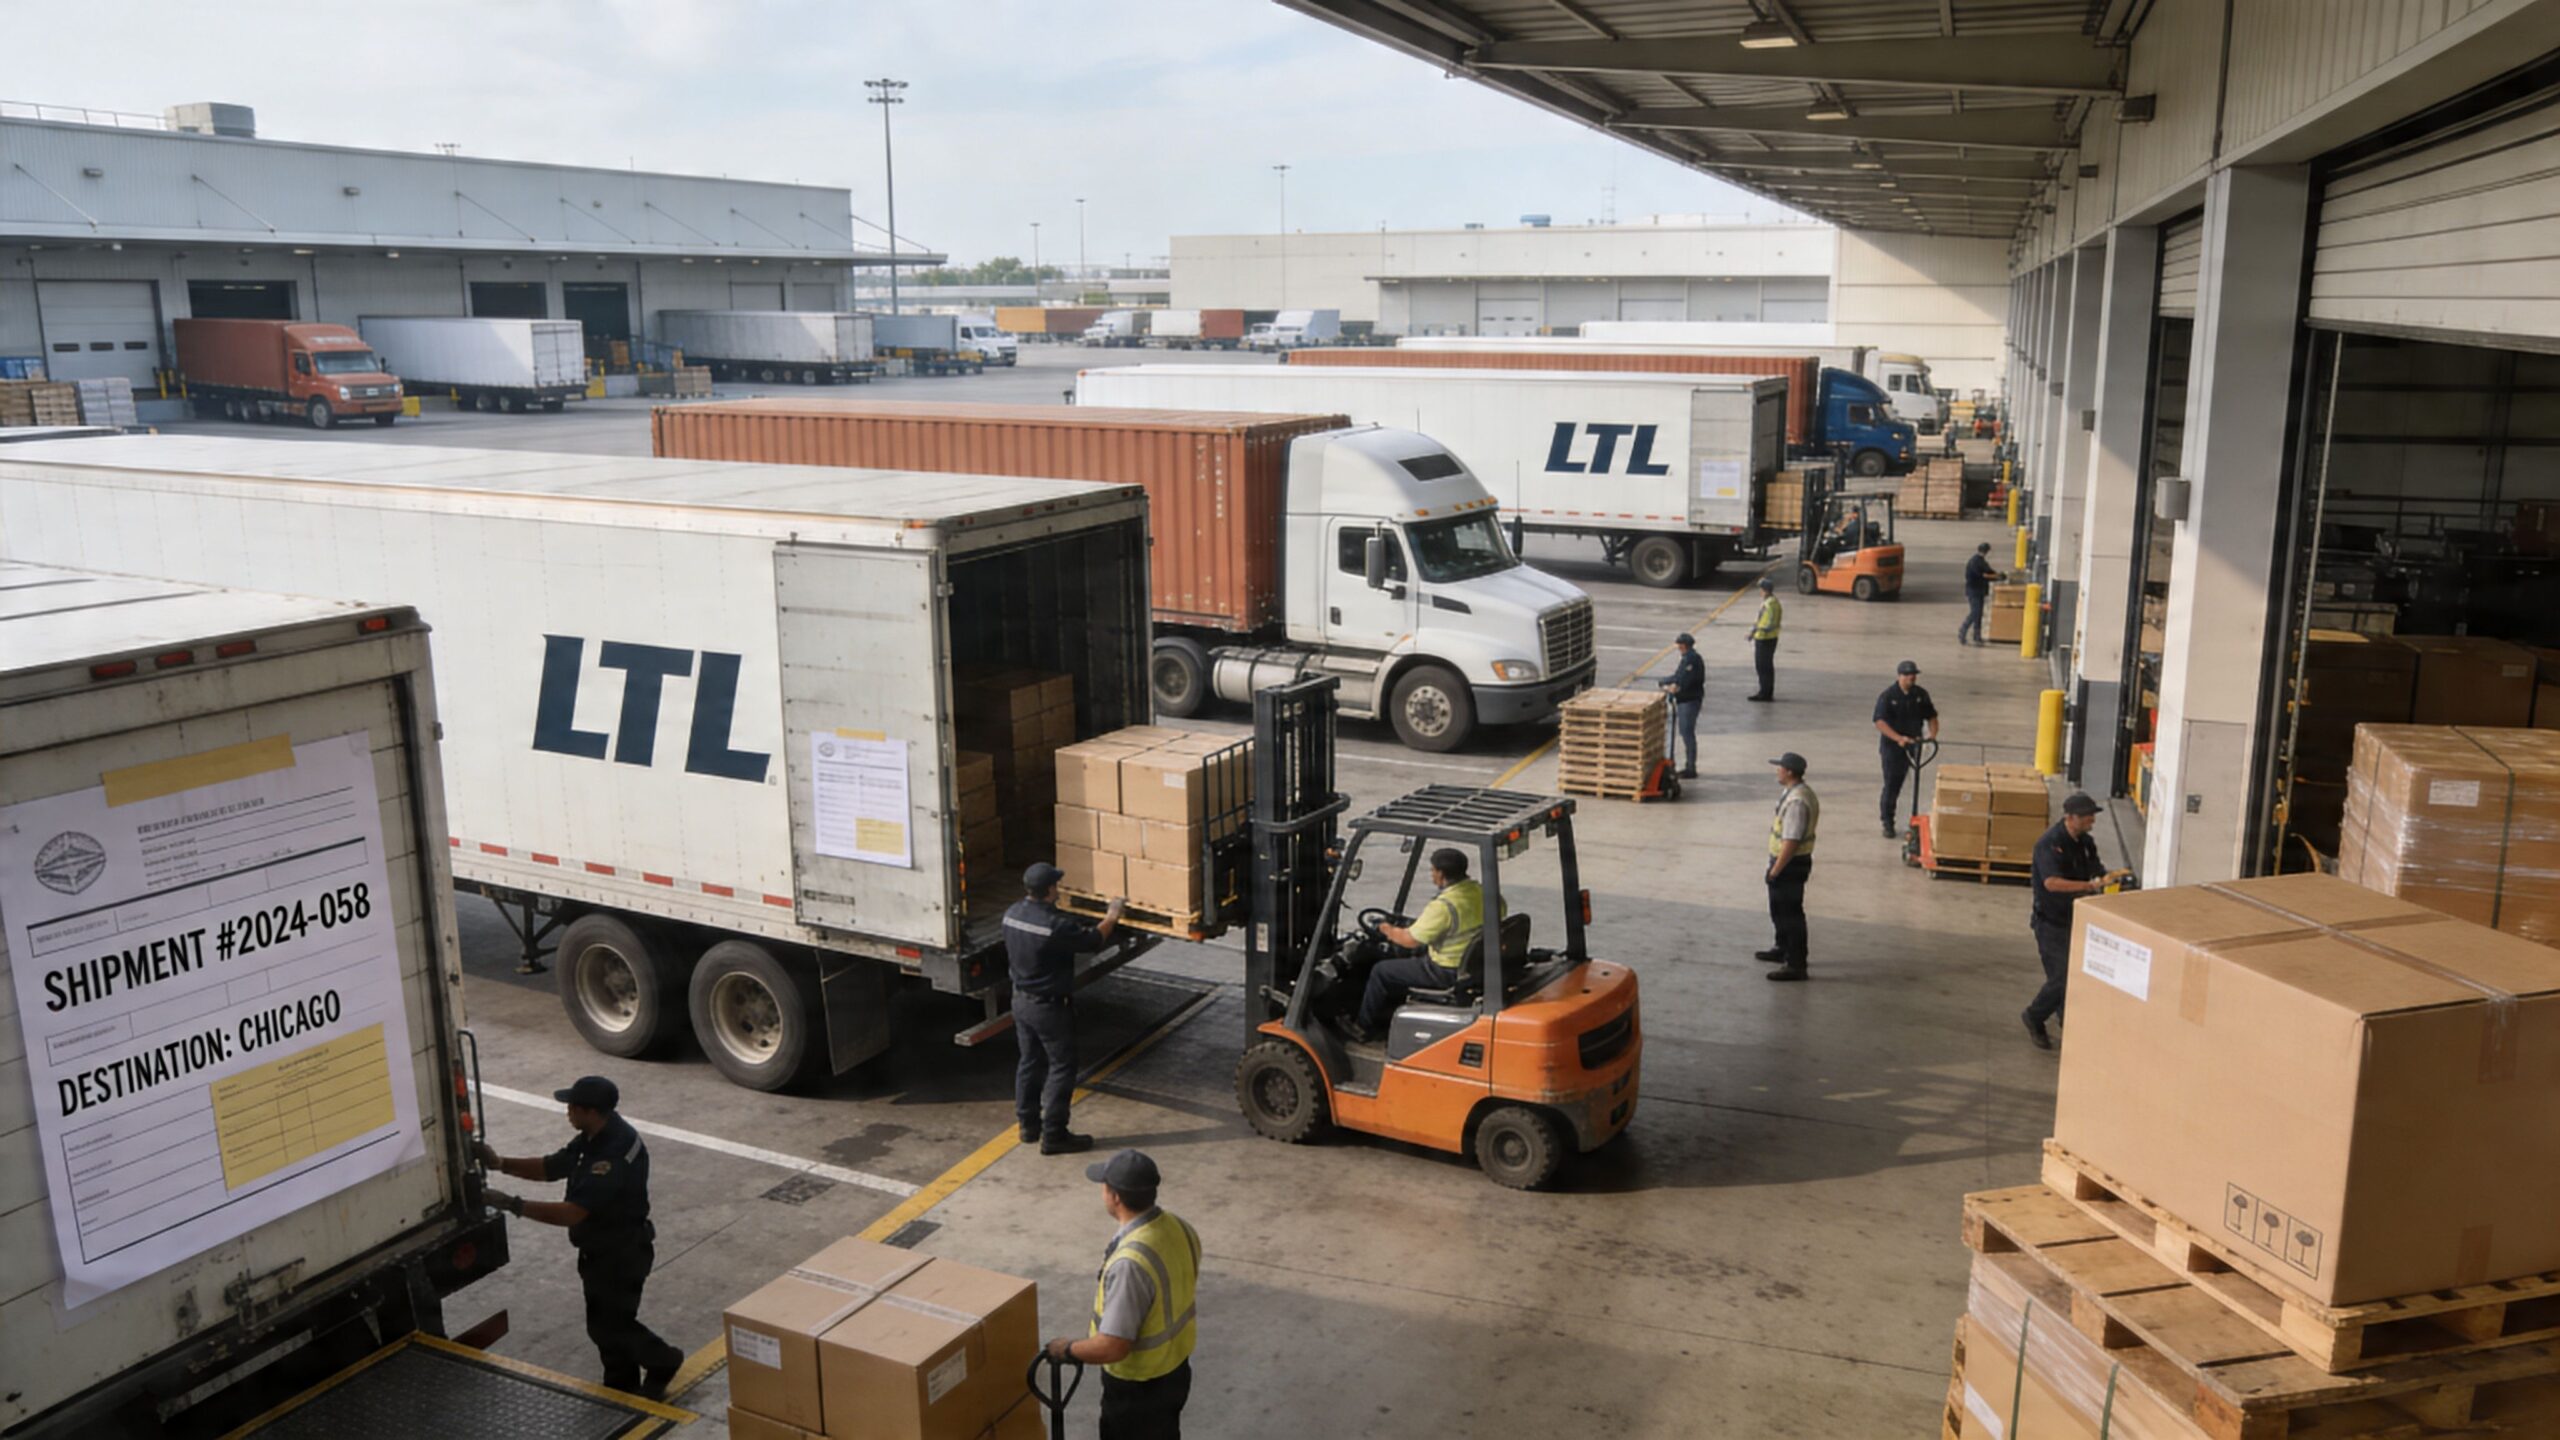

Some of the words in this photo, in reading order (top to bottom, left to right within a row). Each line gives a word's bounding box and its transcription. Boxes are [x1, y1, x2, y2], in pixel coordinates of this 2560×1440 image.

[1544, 421, 1670, 476] LTL
[532, 634, 772, 784] LTL
[44, 928, 208, 1012] SHIPMENT
[215, 882, 372, 962] #2024-058
[57, 1027, 234, 1117] DESTINATION:
[238, 989, 342, 1053] CHICAGO
